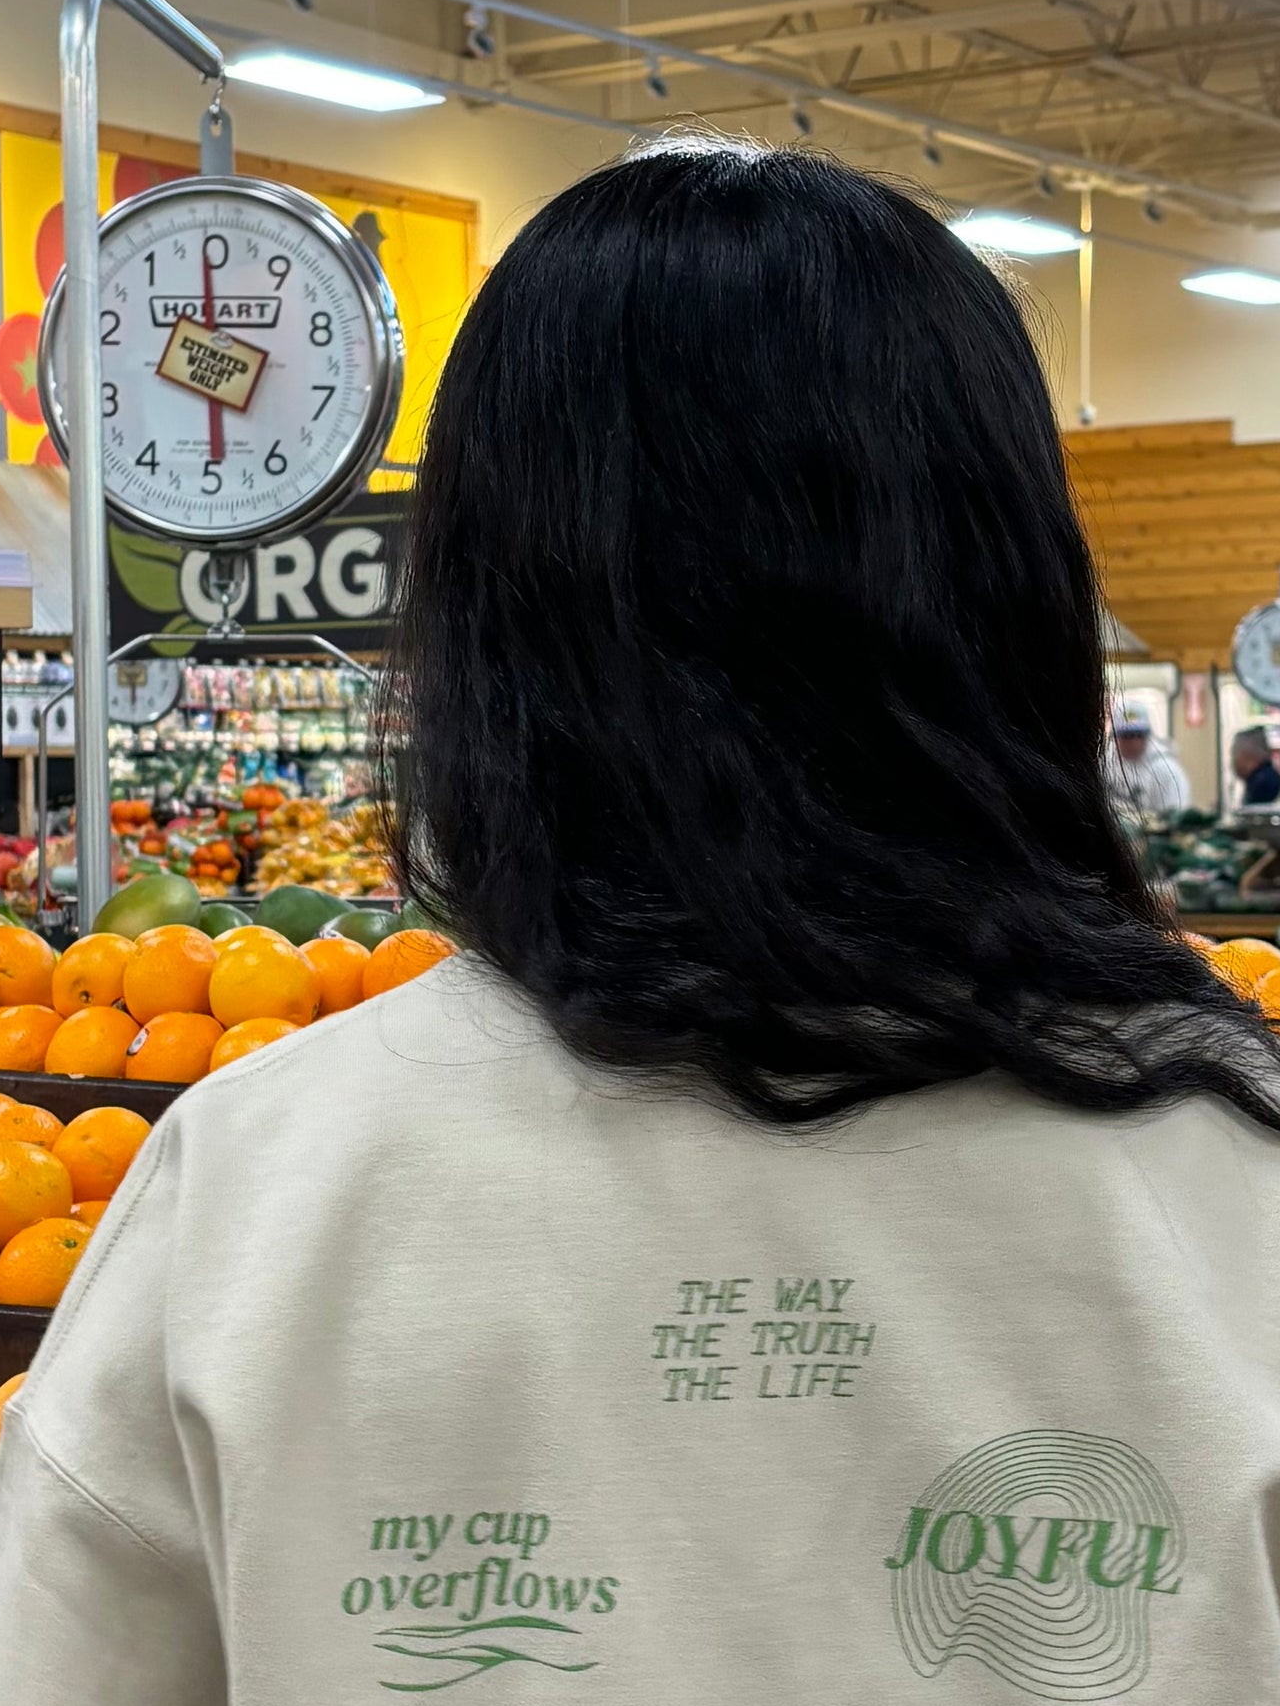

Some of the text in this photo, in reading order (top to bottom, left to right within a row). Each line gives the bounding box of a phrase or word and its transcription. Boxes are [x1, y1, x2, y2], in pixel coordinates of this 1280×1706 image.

[677, 1276, 856, 1316] THE WAY
[650, 1320, 877, 1361] THE TRUTH
[661, 1363, 861, 1404] THE LIFE
[369, 1504, 551, 1563] my cup
[880, 1505, 1186, 1599] JOYFUL
[340, 1558, 619, 1624] overflows
